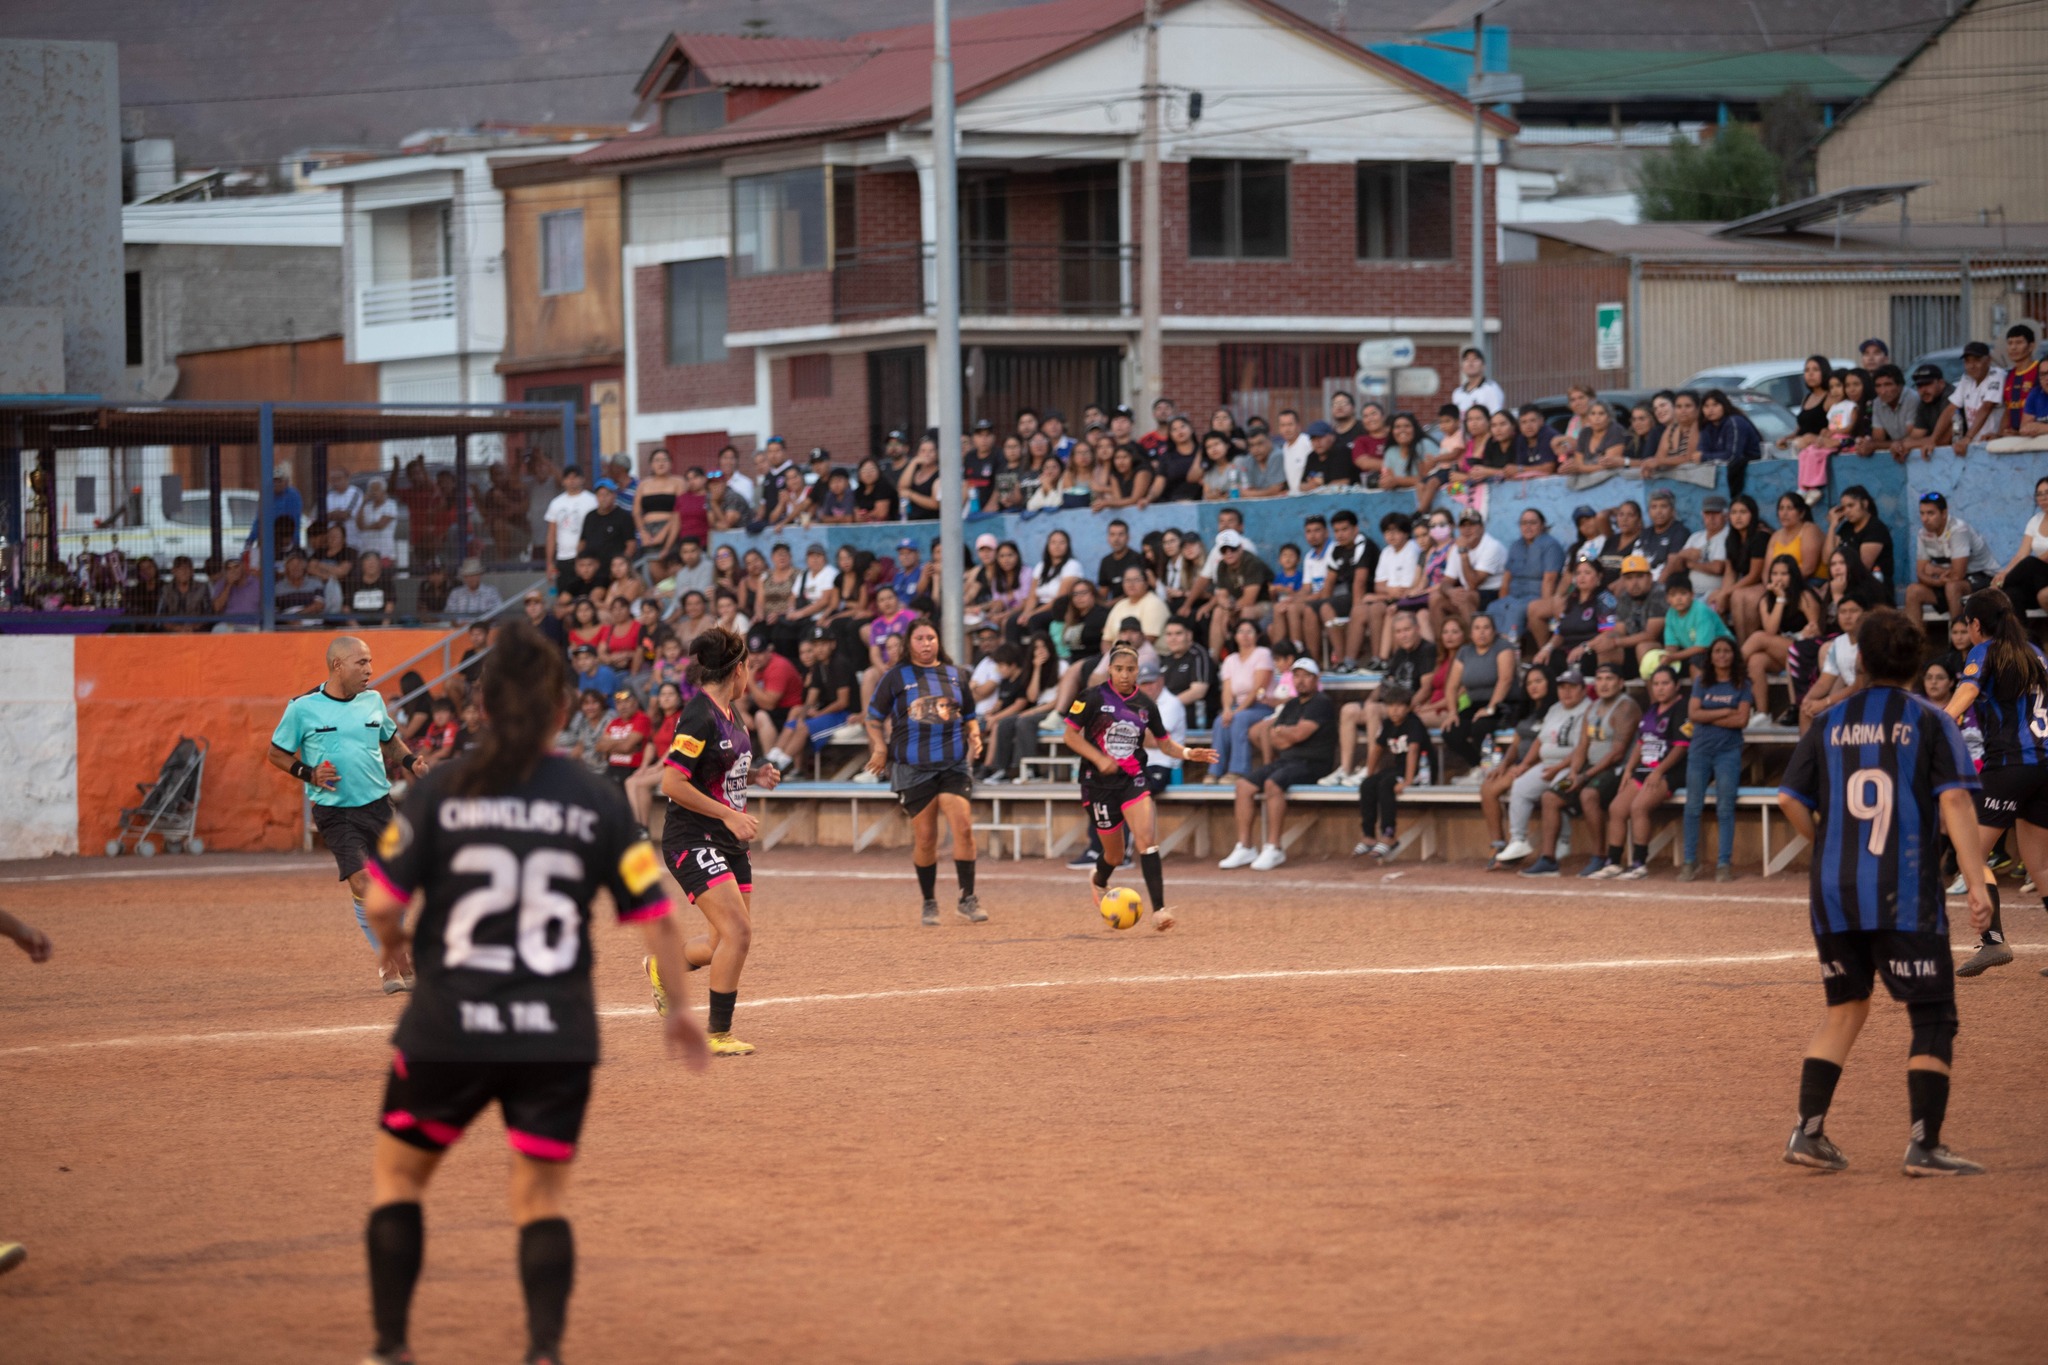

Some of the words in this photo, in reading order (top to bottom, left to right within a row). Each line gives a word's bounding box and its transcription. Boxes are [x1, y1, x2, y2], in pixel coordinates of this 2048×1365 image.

[1831, 724, 1885, 746] KARINA
[1891, 723, 1912, 745] FC
[1093, 802, 1110, 822] 14
[1846, 768, 1894, 856] 9
[1984, 797, 2000, 811] TAL
[2002, 800, 2017, 812] TAL
[566, 803, 598, 842] FC
[443, 843, 584, 977] 26
[1888, 960, 1911, 977] TAL
[1913, 960, 1937, 977] TAL
